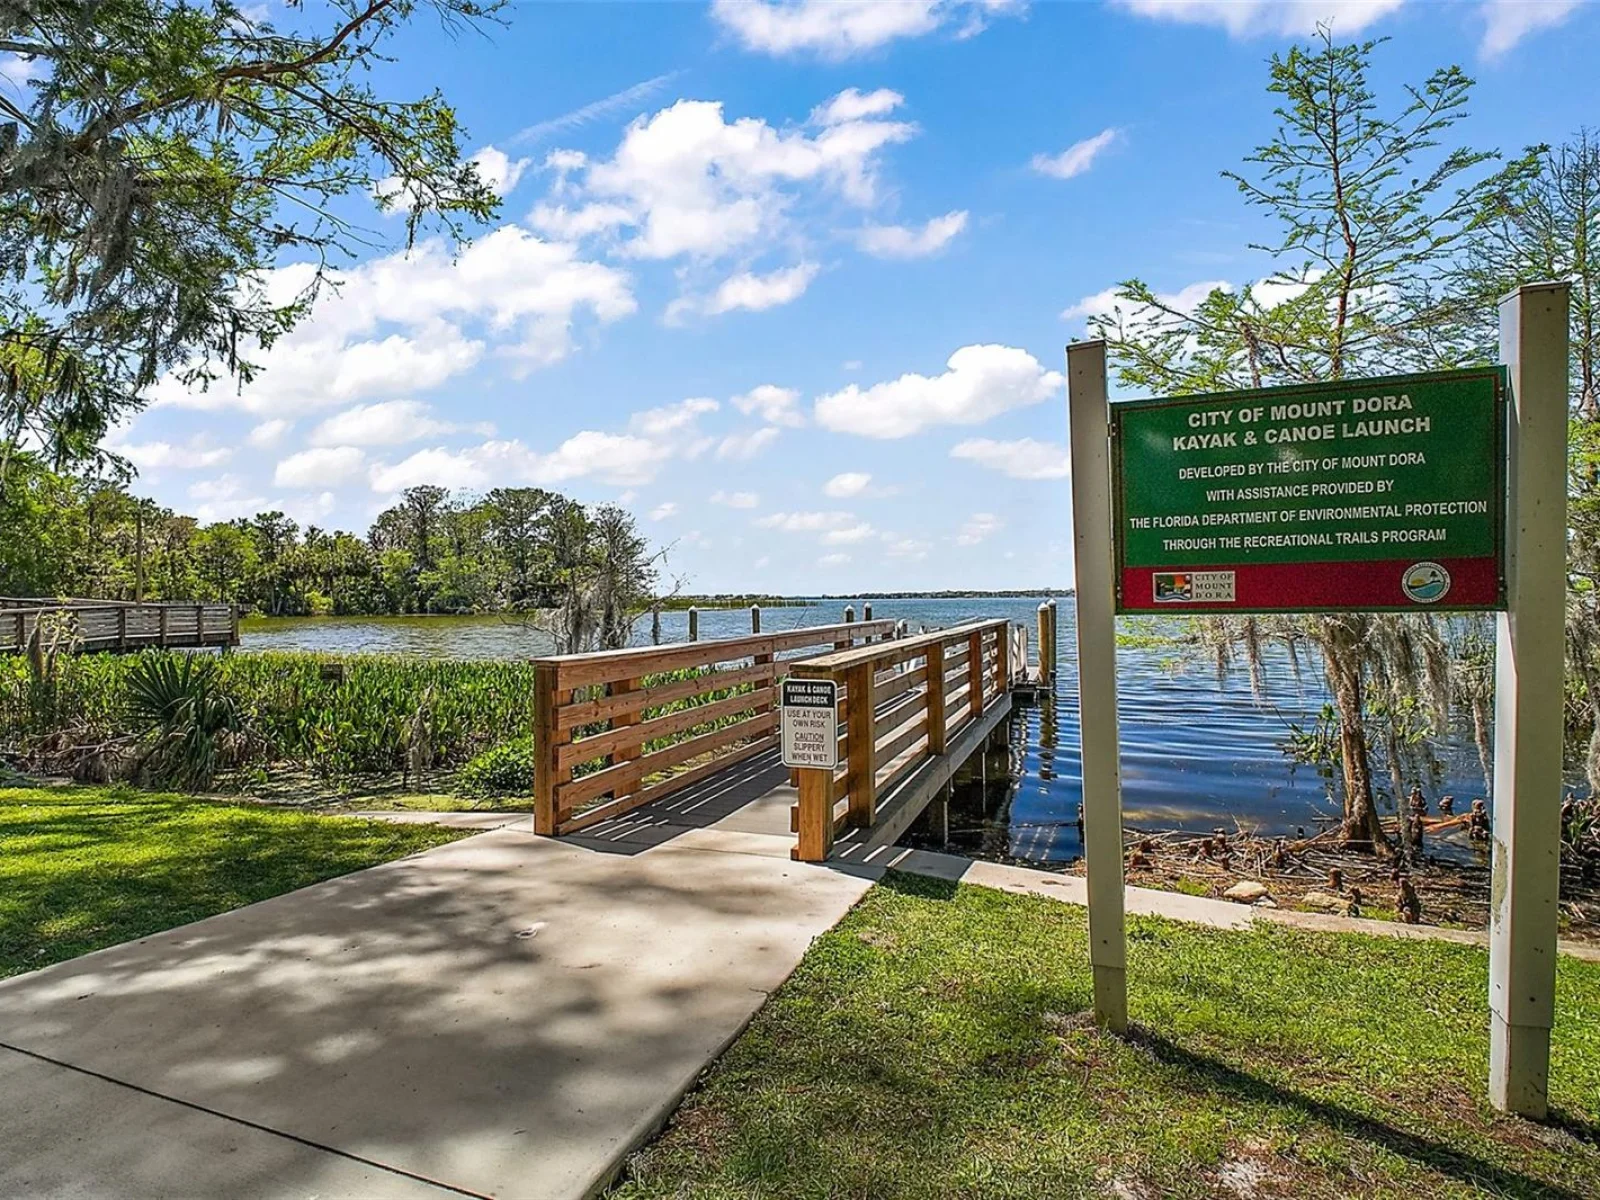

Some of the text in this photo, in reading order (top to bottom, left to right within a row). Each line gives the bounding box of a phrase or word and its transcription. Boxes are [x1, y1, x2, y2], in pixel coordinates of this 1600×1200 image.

[1188, 394, 1413, 427] CITY OF MOUNT DORA
[1173, 416, 1431, 451] KAYAK & CANOE LAUNCH
[1179, 452, 1426, 480] DEVELOPED BY THE CITY OF MOUNT DORA
[1206, 479, 1395, 502] WITH ASSISTANCE PROVIDED BY
[1130, 501, 1487, 529] THE FLORIDA DEPARTMENT OF ENVIRONMENTAL PROTECTION
[1163, 529, 1446, 550] THROUGH THE RECREATIONAL TRAILS PROGRAM
[1194, 573, 1217, 581] CITY
[786, 685, 806, 693] KAYAK
[812, 686, 832, 694] CANOE
[789, 695, 828, 704] LAUNCH DECK
[787, 709, 831, 719] USE AT YOUR
[792, 719, 825, 728] OWN RISK
[794, 732, 824, 741] CAUTION
[793, 742, 825, 752] SLIPPERY
[791, 752, 828, 762] WHEN WET
